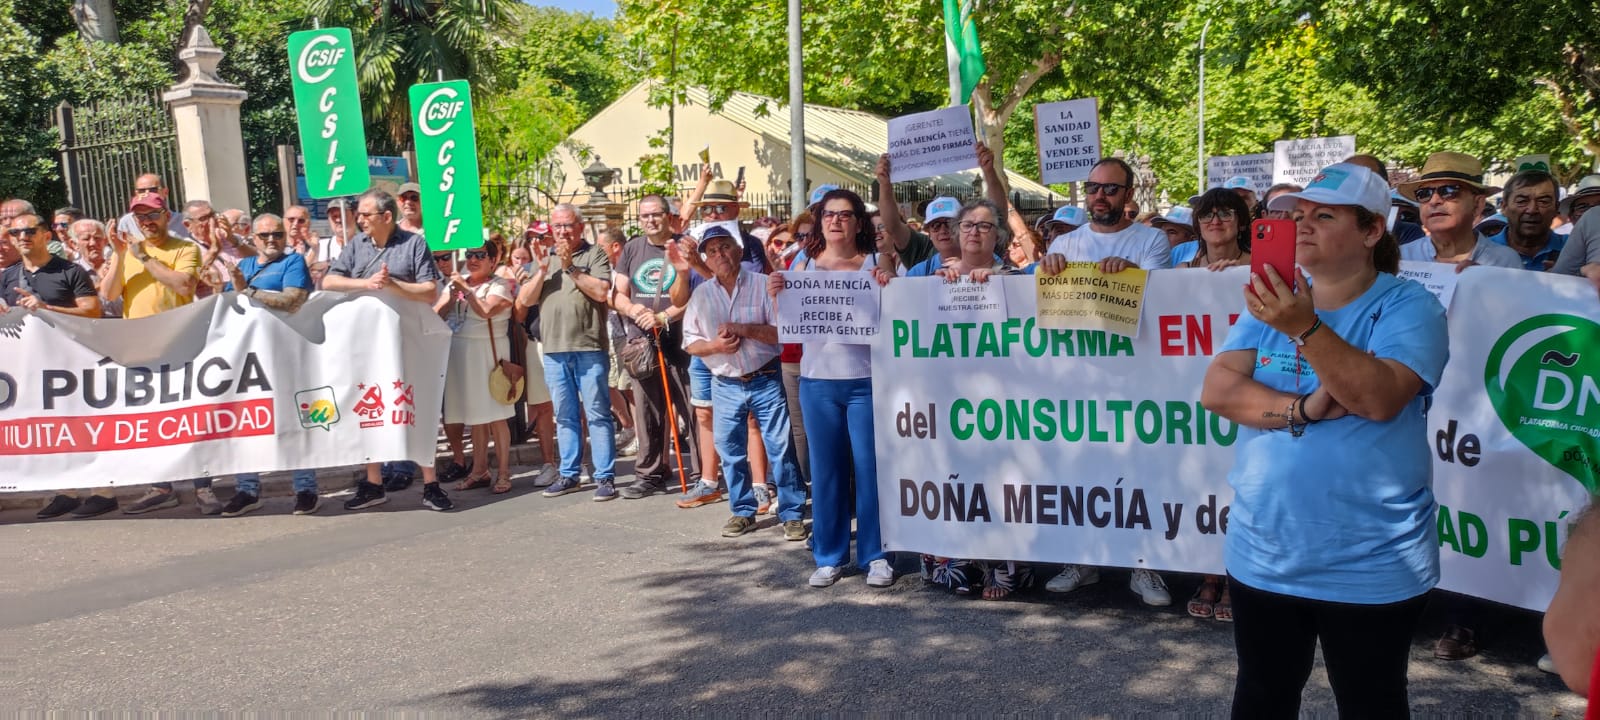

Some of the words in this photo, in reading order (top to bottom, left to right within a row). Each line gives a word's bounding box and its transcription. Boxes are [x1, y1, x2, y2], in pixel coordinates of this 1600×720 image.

[1061, 111, 1073, 120] LA
[1045, 121, 1091, 133] SANIDAD
[319, 87, 345, 191] CSIF
[890, 137, 912, 149] DOÑA
[914, 131, 946, 144] MENCÍA
[948, 126, 970, 138] TIENE
[1054, 136, 1069, 145] NO
[1072, 134, 1084, 143] SE
[910, 148, 921, 156] DE
[922, 144, 941, 154] 2100
[943, 138, 973, 150] FIRMAS
[1046, 147, 1080, 158] VENDE
[1082, 145, 1095, 155] SE
[1046, 158, 1097, 171] DEFIENDE
[437, 140, 461, 243] CSIF
[784, 278, 820, 290] DOÑA
[824, 278, 872, 290] MENCÍA
[1040, 275, 1068, 286] DOÑA
[1070, 276, 1109, 289] MENCÍA
[1111, 281, 1141, 295] TIENE
[801, 296, 855, 307] ¡GERENTE!
[938, 304, 972, 312] NUESTRA
[973, 303, 1000, 311] GENTE!
[1042, 290, 1061, 300] MÁS
[1064, 291, 1075, 300] DE
[1076, 291, 1097, 300] 2100
[1100, 293, 1138, 309] FIRMAS
[800, 311, 842, 322] ¡RECIBE
[845, 312, 854, 322] A
[782, 325, 834, 335] NUESTRA
[836, 325, 875, 336] GENTE!
[892, 317, 1135, 358] PLATAFORMA
[1159, 315, 1213, 357] EN
[42, 352, 273, 410] PÚBLICA
[85, 422, 104, 445] Y
[115, 419, 149, 444] DE
[158, 404, 272, 440] CALIDAD
[1520, 416, 1568, 431] PLATAFORMA
[895, 402, 937, 440] del
[949, 398, 1239, 447] CONSULTORIO
[1436, 420, 1481, 467] de
[900, 474, 992, 523] DOÑA
[1003, 477, 1152, 530] MENCÍA
[1163, 501, 1183, 541] y
